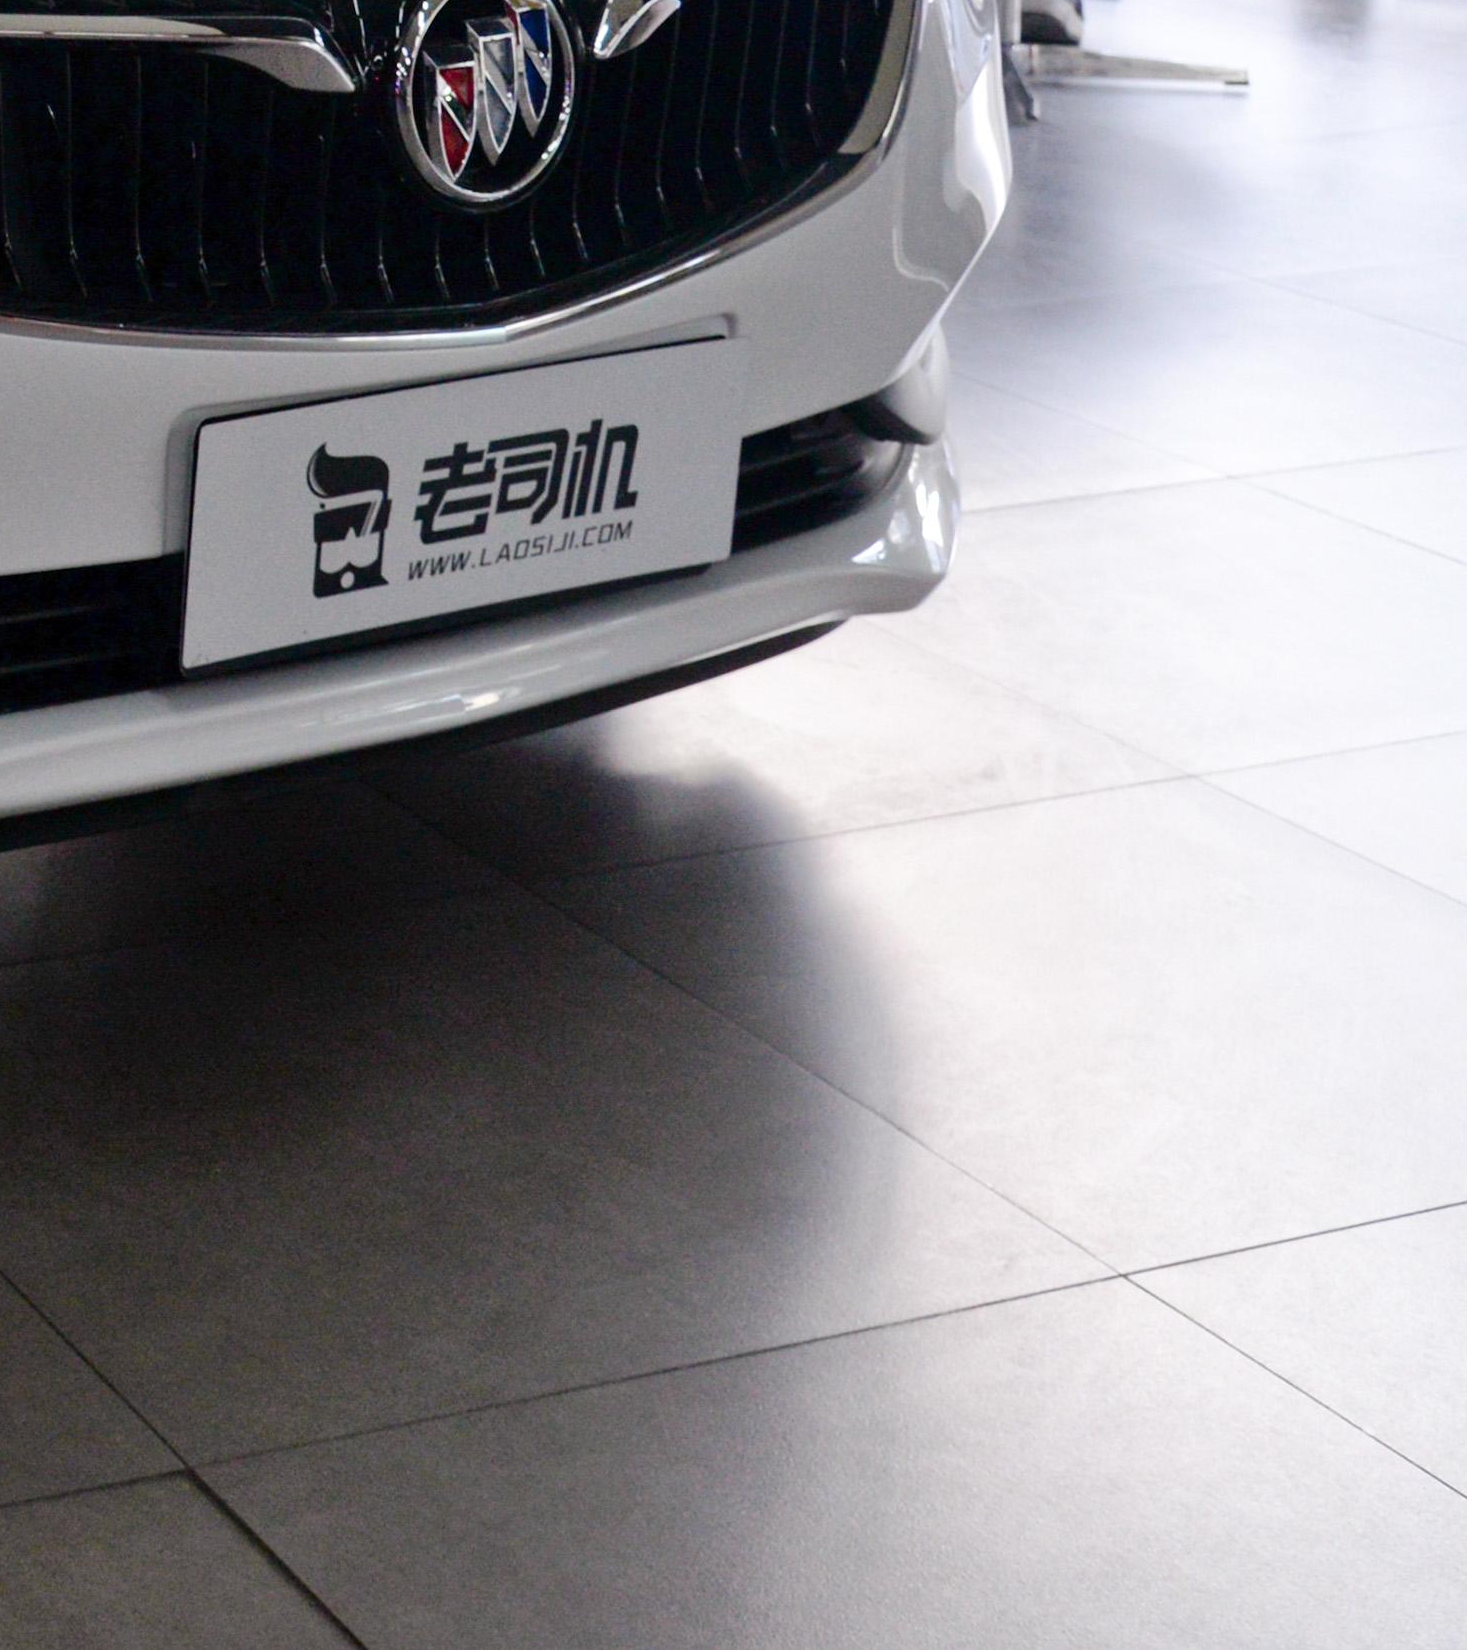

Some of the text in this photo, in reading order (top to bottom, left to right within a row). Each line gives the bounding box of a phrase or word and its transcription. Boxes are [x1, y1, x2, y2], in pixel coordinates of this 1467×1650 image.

[414, 419, 639, 545] 老司机
[407, 520, 635, 581] WWW.LAOSIJI.COM
